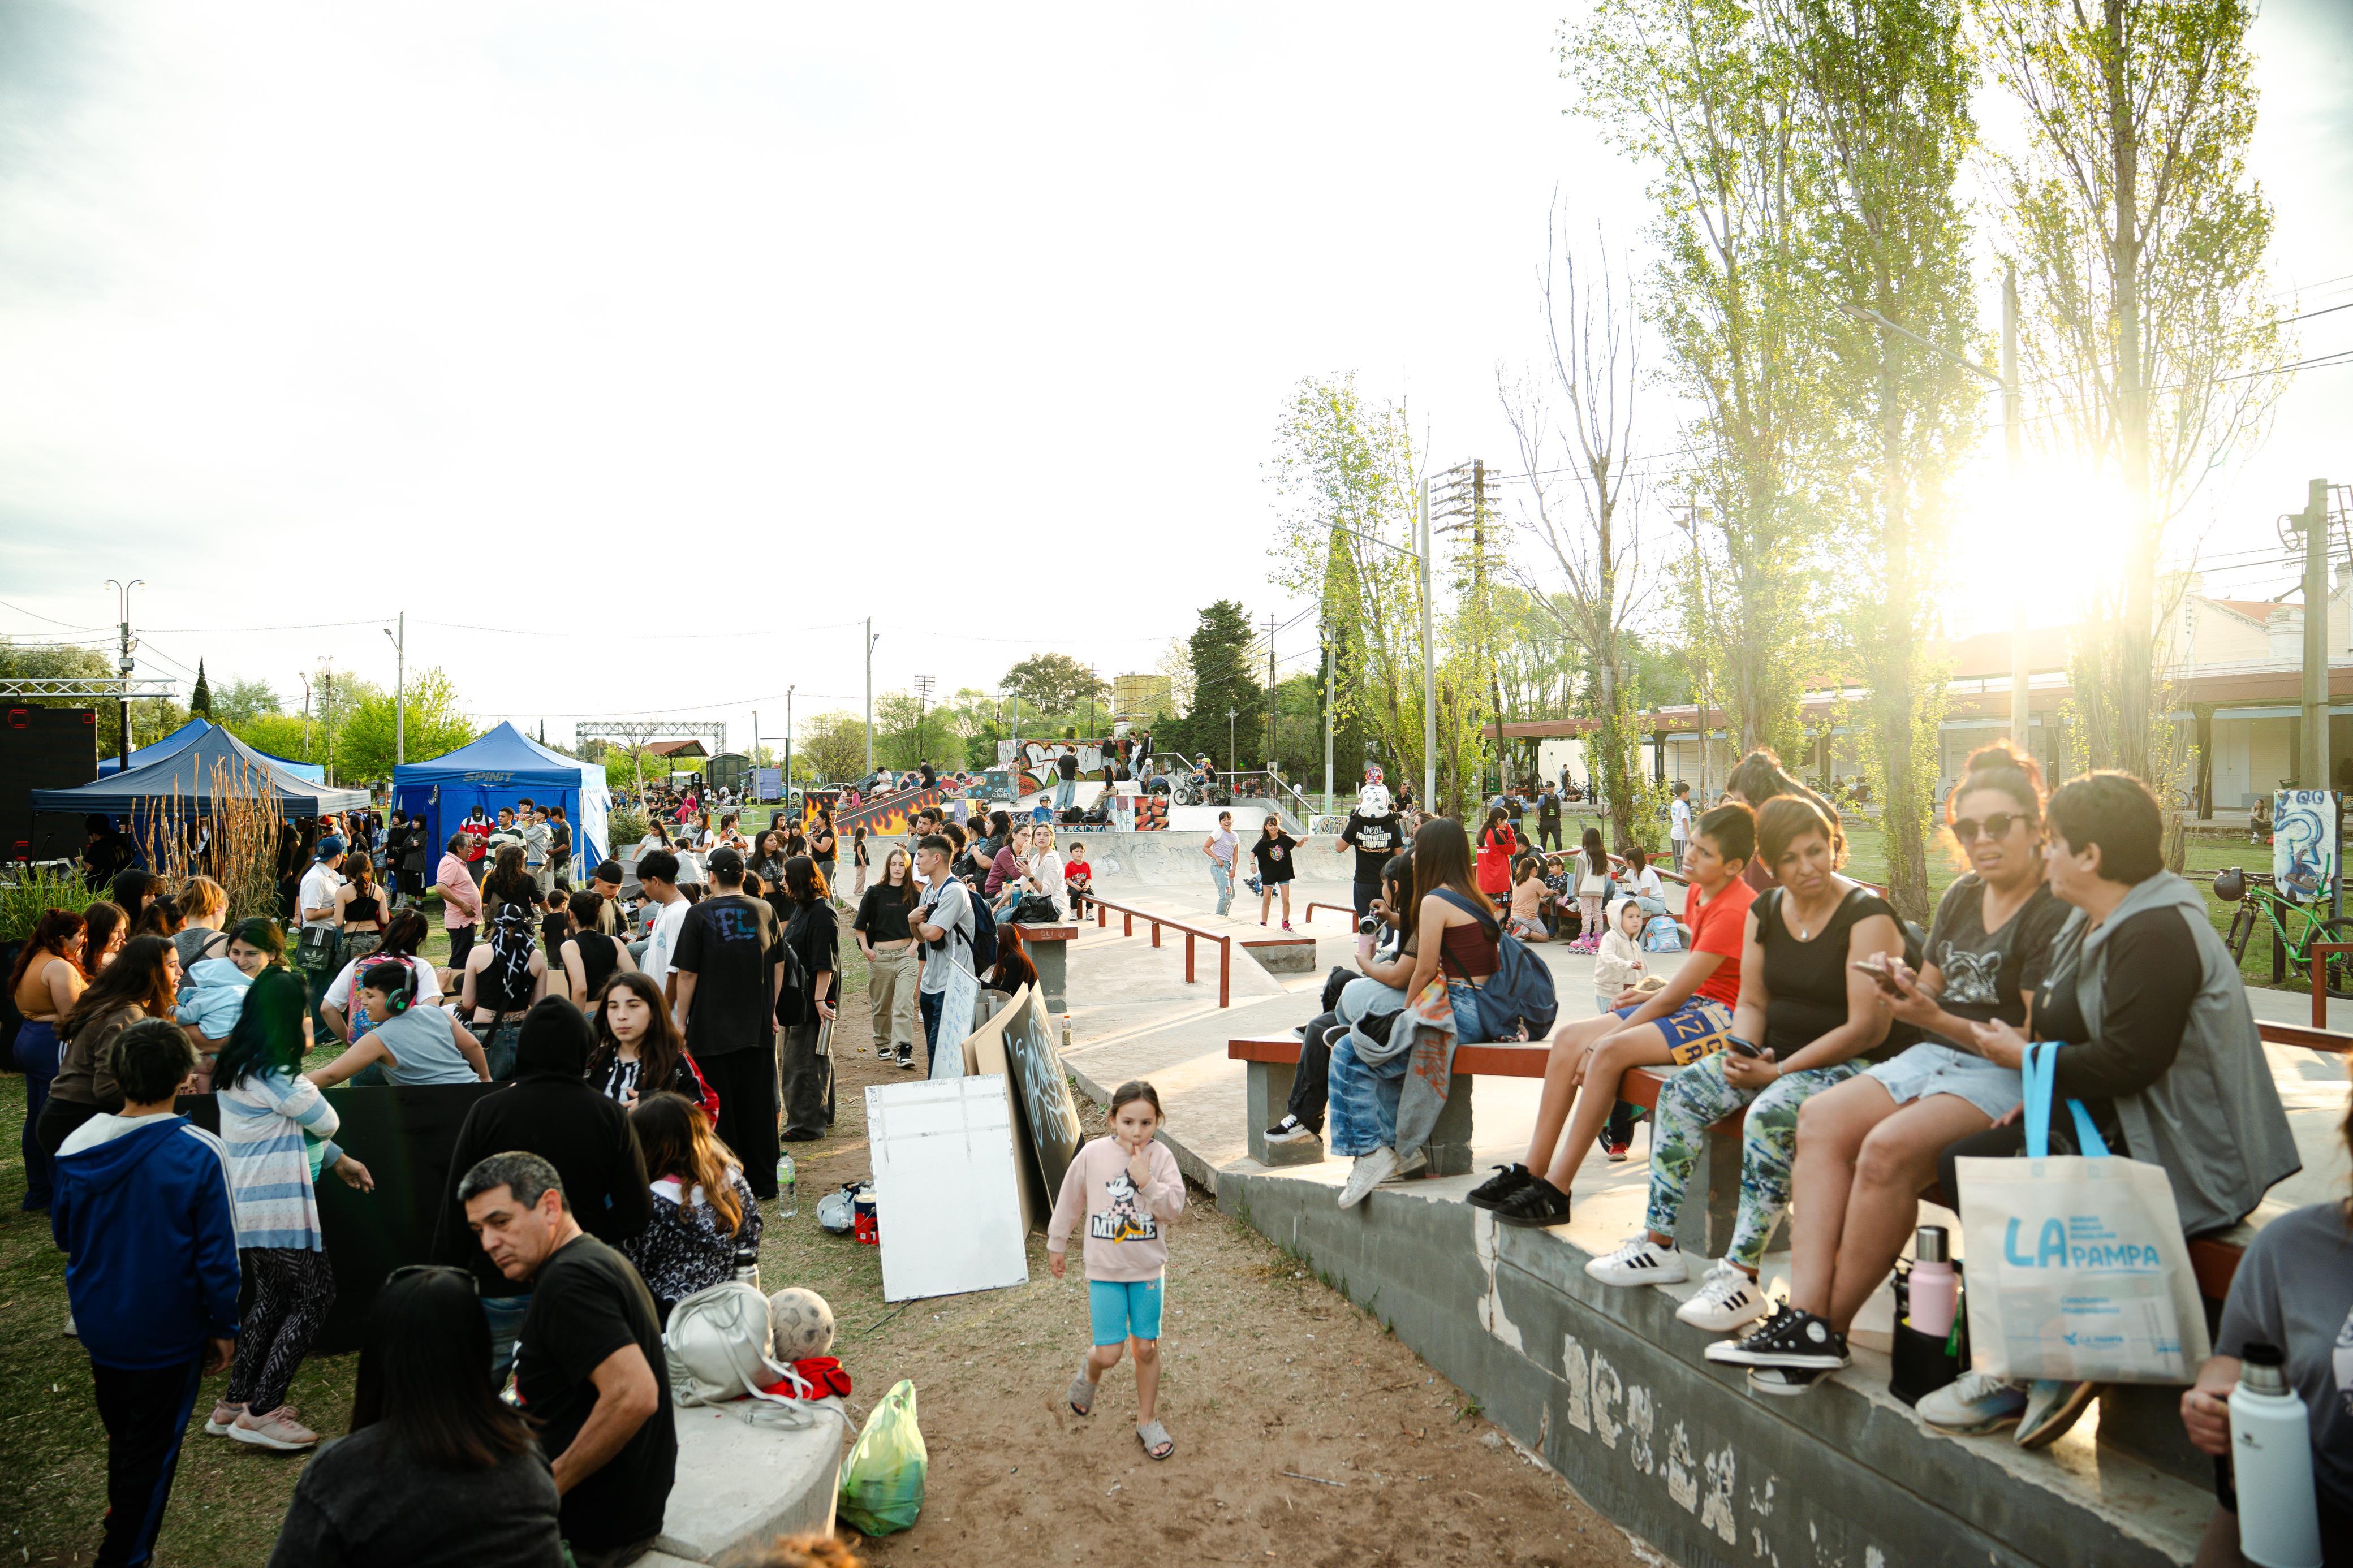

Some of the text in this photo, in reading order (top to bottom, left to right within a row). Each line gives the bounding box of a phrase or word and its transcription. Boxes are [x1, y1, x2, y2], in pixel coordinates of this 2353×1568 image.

[1356, 832, 1391, 841] FAMILY ATELIER
[2004, 1217, 2160, 1268] LA PAMPA
